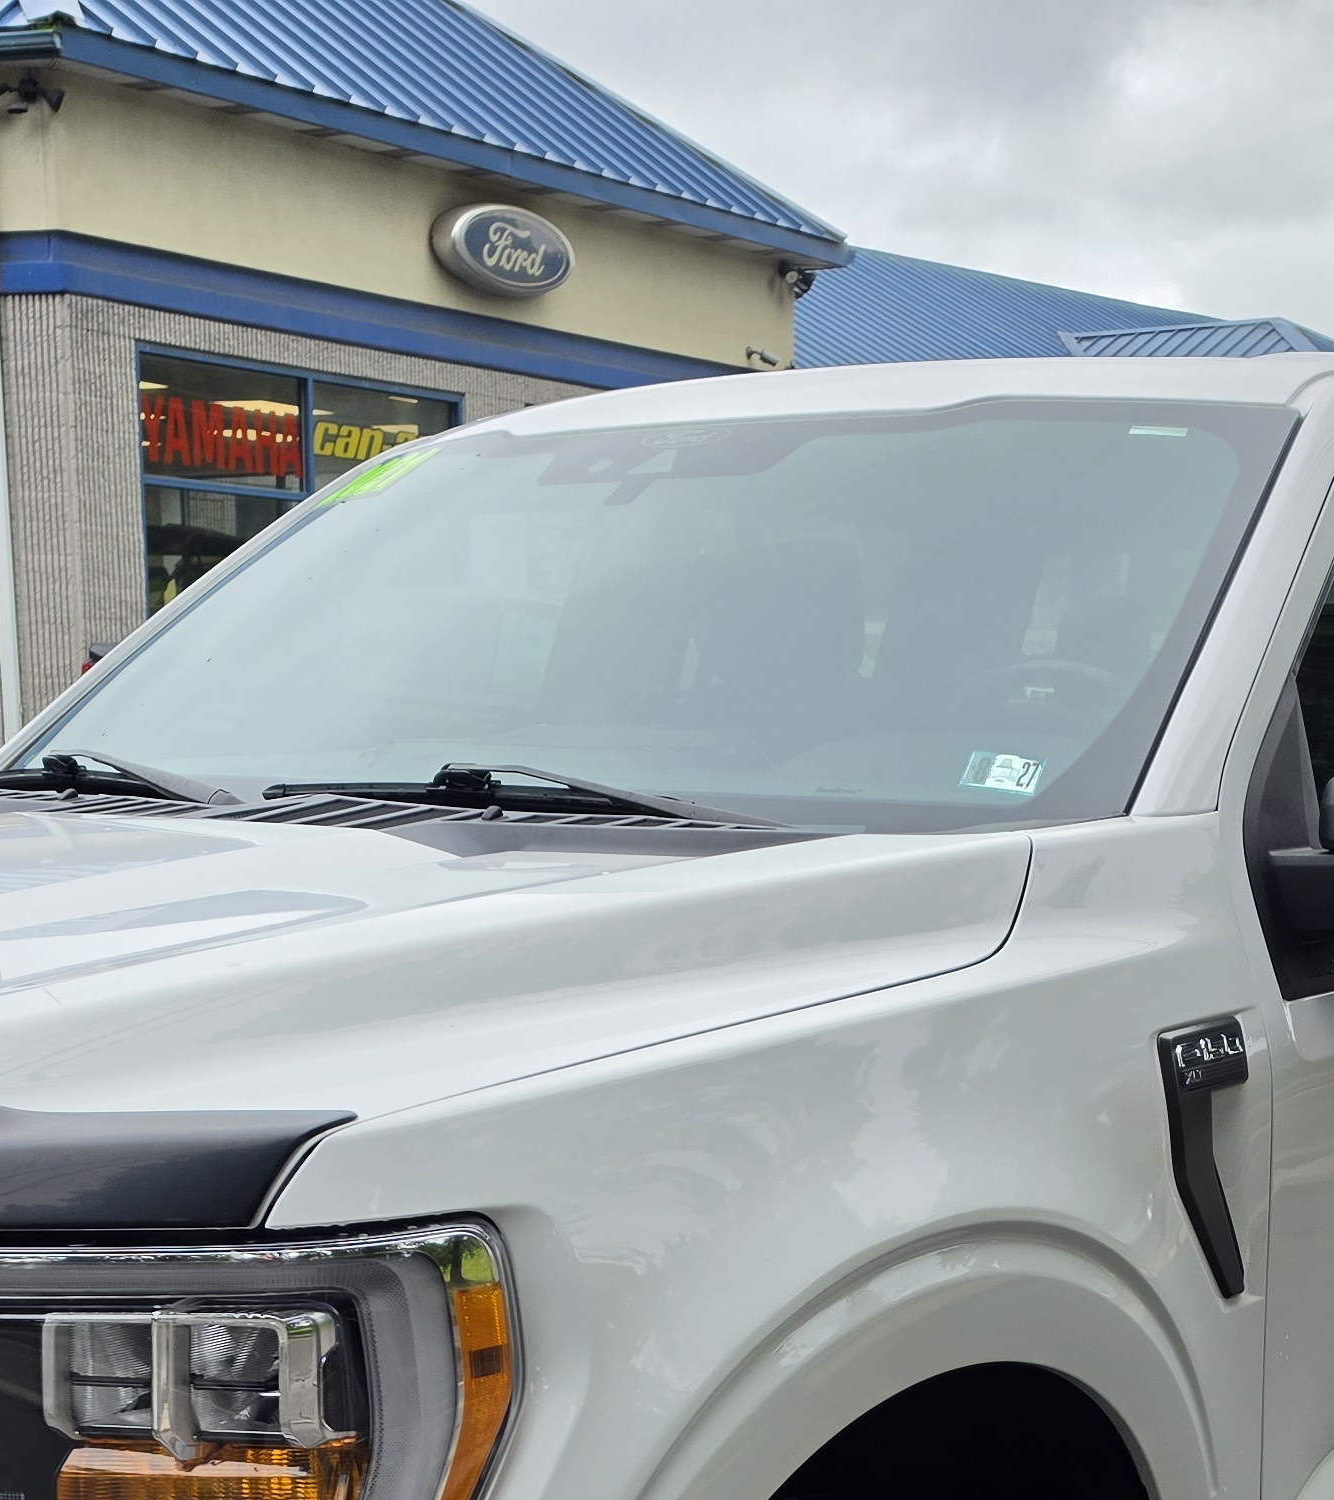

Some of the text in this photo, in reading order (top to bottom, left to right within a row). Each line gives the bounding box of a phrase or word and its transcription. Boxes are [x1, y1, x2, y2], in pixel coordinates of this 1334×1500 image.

[482, 220, 547, 278] Ford
[141, 393, 304, 479] YAMAHA
[1015, 761, 1042, 790] 27
